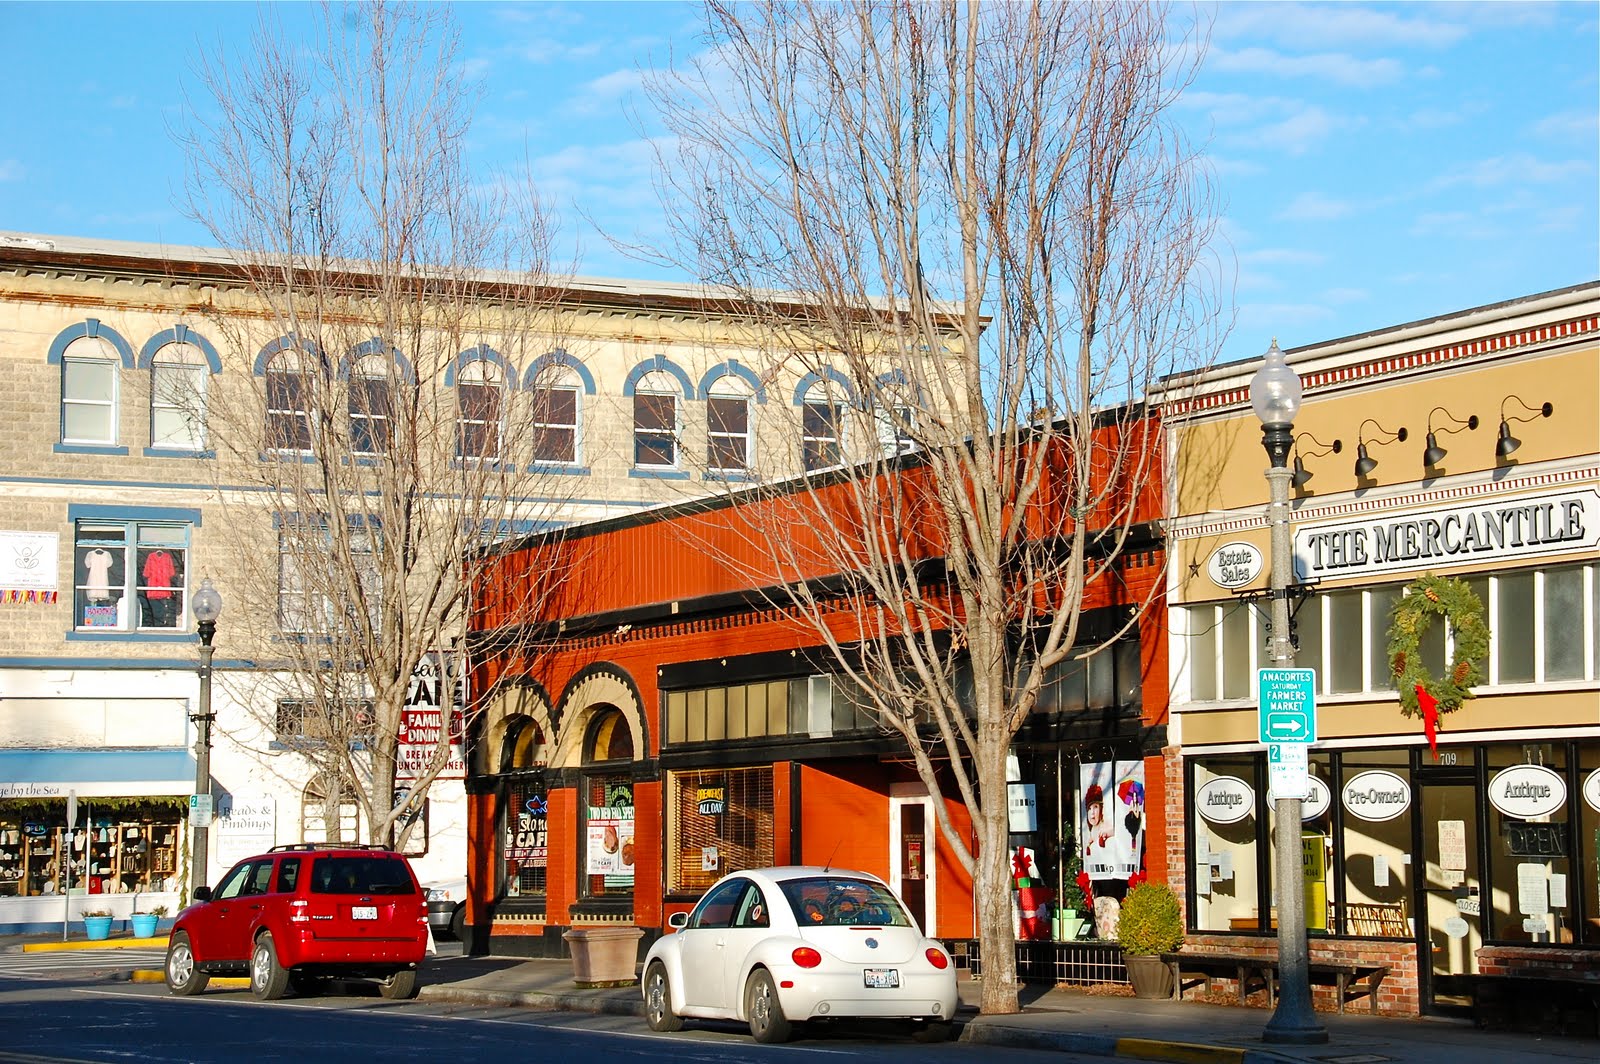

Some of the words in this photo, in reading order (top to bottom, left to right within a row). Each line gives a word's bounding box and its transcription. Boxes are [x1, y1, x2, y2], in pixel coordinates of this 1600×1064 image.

[1308, 527, 1368, 570] THE
[1374, 499, 1585, 564] MERCANTILE
[1218, 549, 1252, 566] Estate
[1221, 566, 1250, 583] Sales
[1262, 672, 1310, 682] ANACORTES
[1267, 691, 1307, 700] FARMERS
[1270, 701, 1303, 711] MARKET
[408, 714, 441, 728] FAMIL
[408, 729, 440, 743] DININ
[406, 750, 453, 759] BREAKT
[1271, 745, 1278, 760] 2
[1440, 752, 1457, 767] 709
[398, 761, 422, 770] UNCH
[443, 761, 464, 770] NNER
[11, 783, 24, 798] by
[26, 783, 41, 795] the
[43, 786, 60, 795] Sea
[697, 788, 724, 802] BREAKFAST
[1347, 787, 1405, 806] Pre-Owned
[1504, 781, 1551, 802] Antique
[191, 797, 197, 806] 2
[1206, 789, 1243, 809] Antique
[223, 805, 257, 816] Beads
[261, 805, 271, 815] &
[622, 806, 635, 820] SPEC
[700, 803, 711, 814] ALL
[711, 802, 723, 813] DAY
[24, 825, 44, 833] OPEN
[221, 818, 272, 830] Findings
[516, 832, 548, 847] CAF
[1507, 827, 1563, 854] OPEN
[1458, 900, 1480, 913] CLOSED
